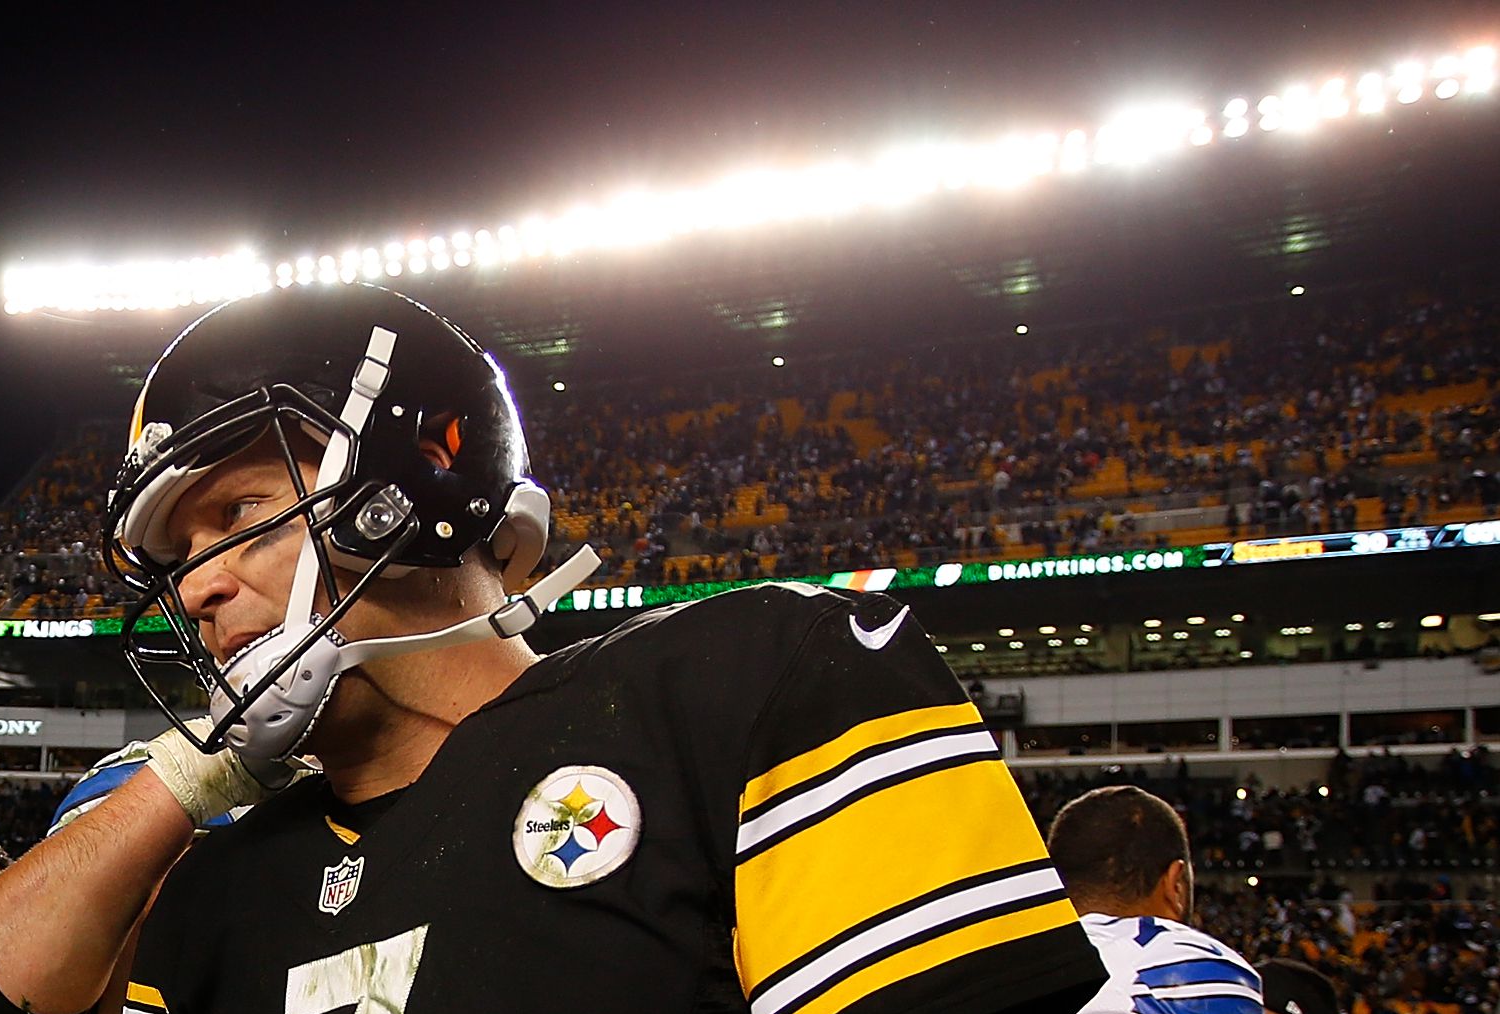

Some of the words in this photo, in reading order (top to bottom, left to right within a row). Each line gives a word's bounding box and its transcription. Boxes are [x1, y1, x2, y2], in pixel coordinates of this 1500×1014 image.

[988, 551, 1184, 581] DRAFTKINGS.COM
[572, 586, 643, 611] WEEK
[526, 818, 570, 833] Steelers
[326, 881, 354, 905] NFL
